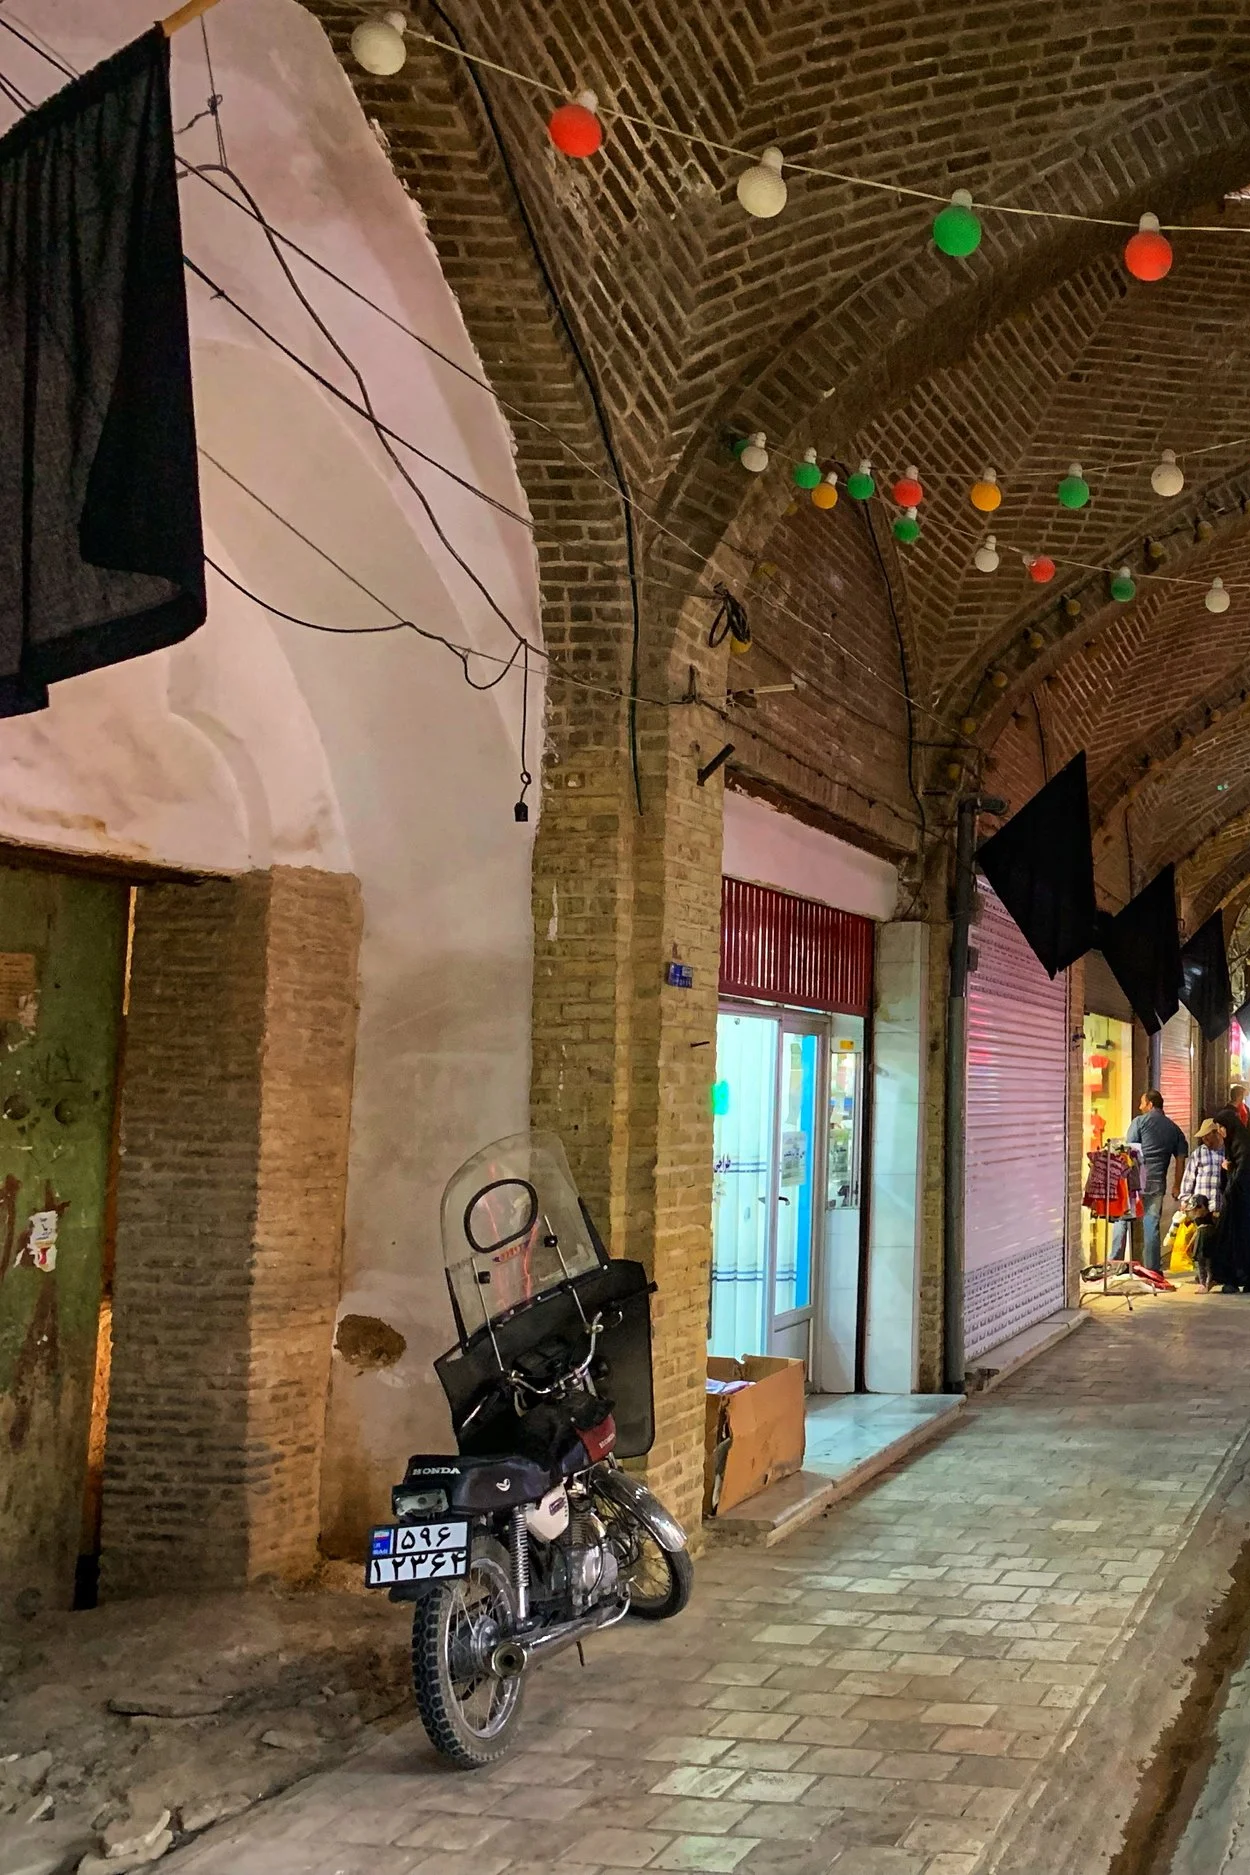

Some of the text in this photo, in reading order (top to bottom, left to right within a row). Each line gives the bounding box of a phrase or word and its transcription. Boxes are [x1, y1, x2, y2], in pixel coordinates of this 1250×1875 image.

[412, 1467, 461, 1476] HONDA
[401, 1526, 451, 1550] ۵۹۶
[374, 1551, 467, 1582] ۱۲۳۶۴
